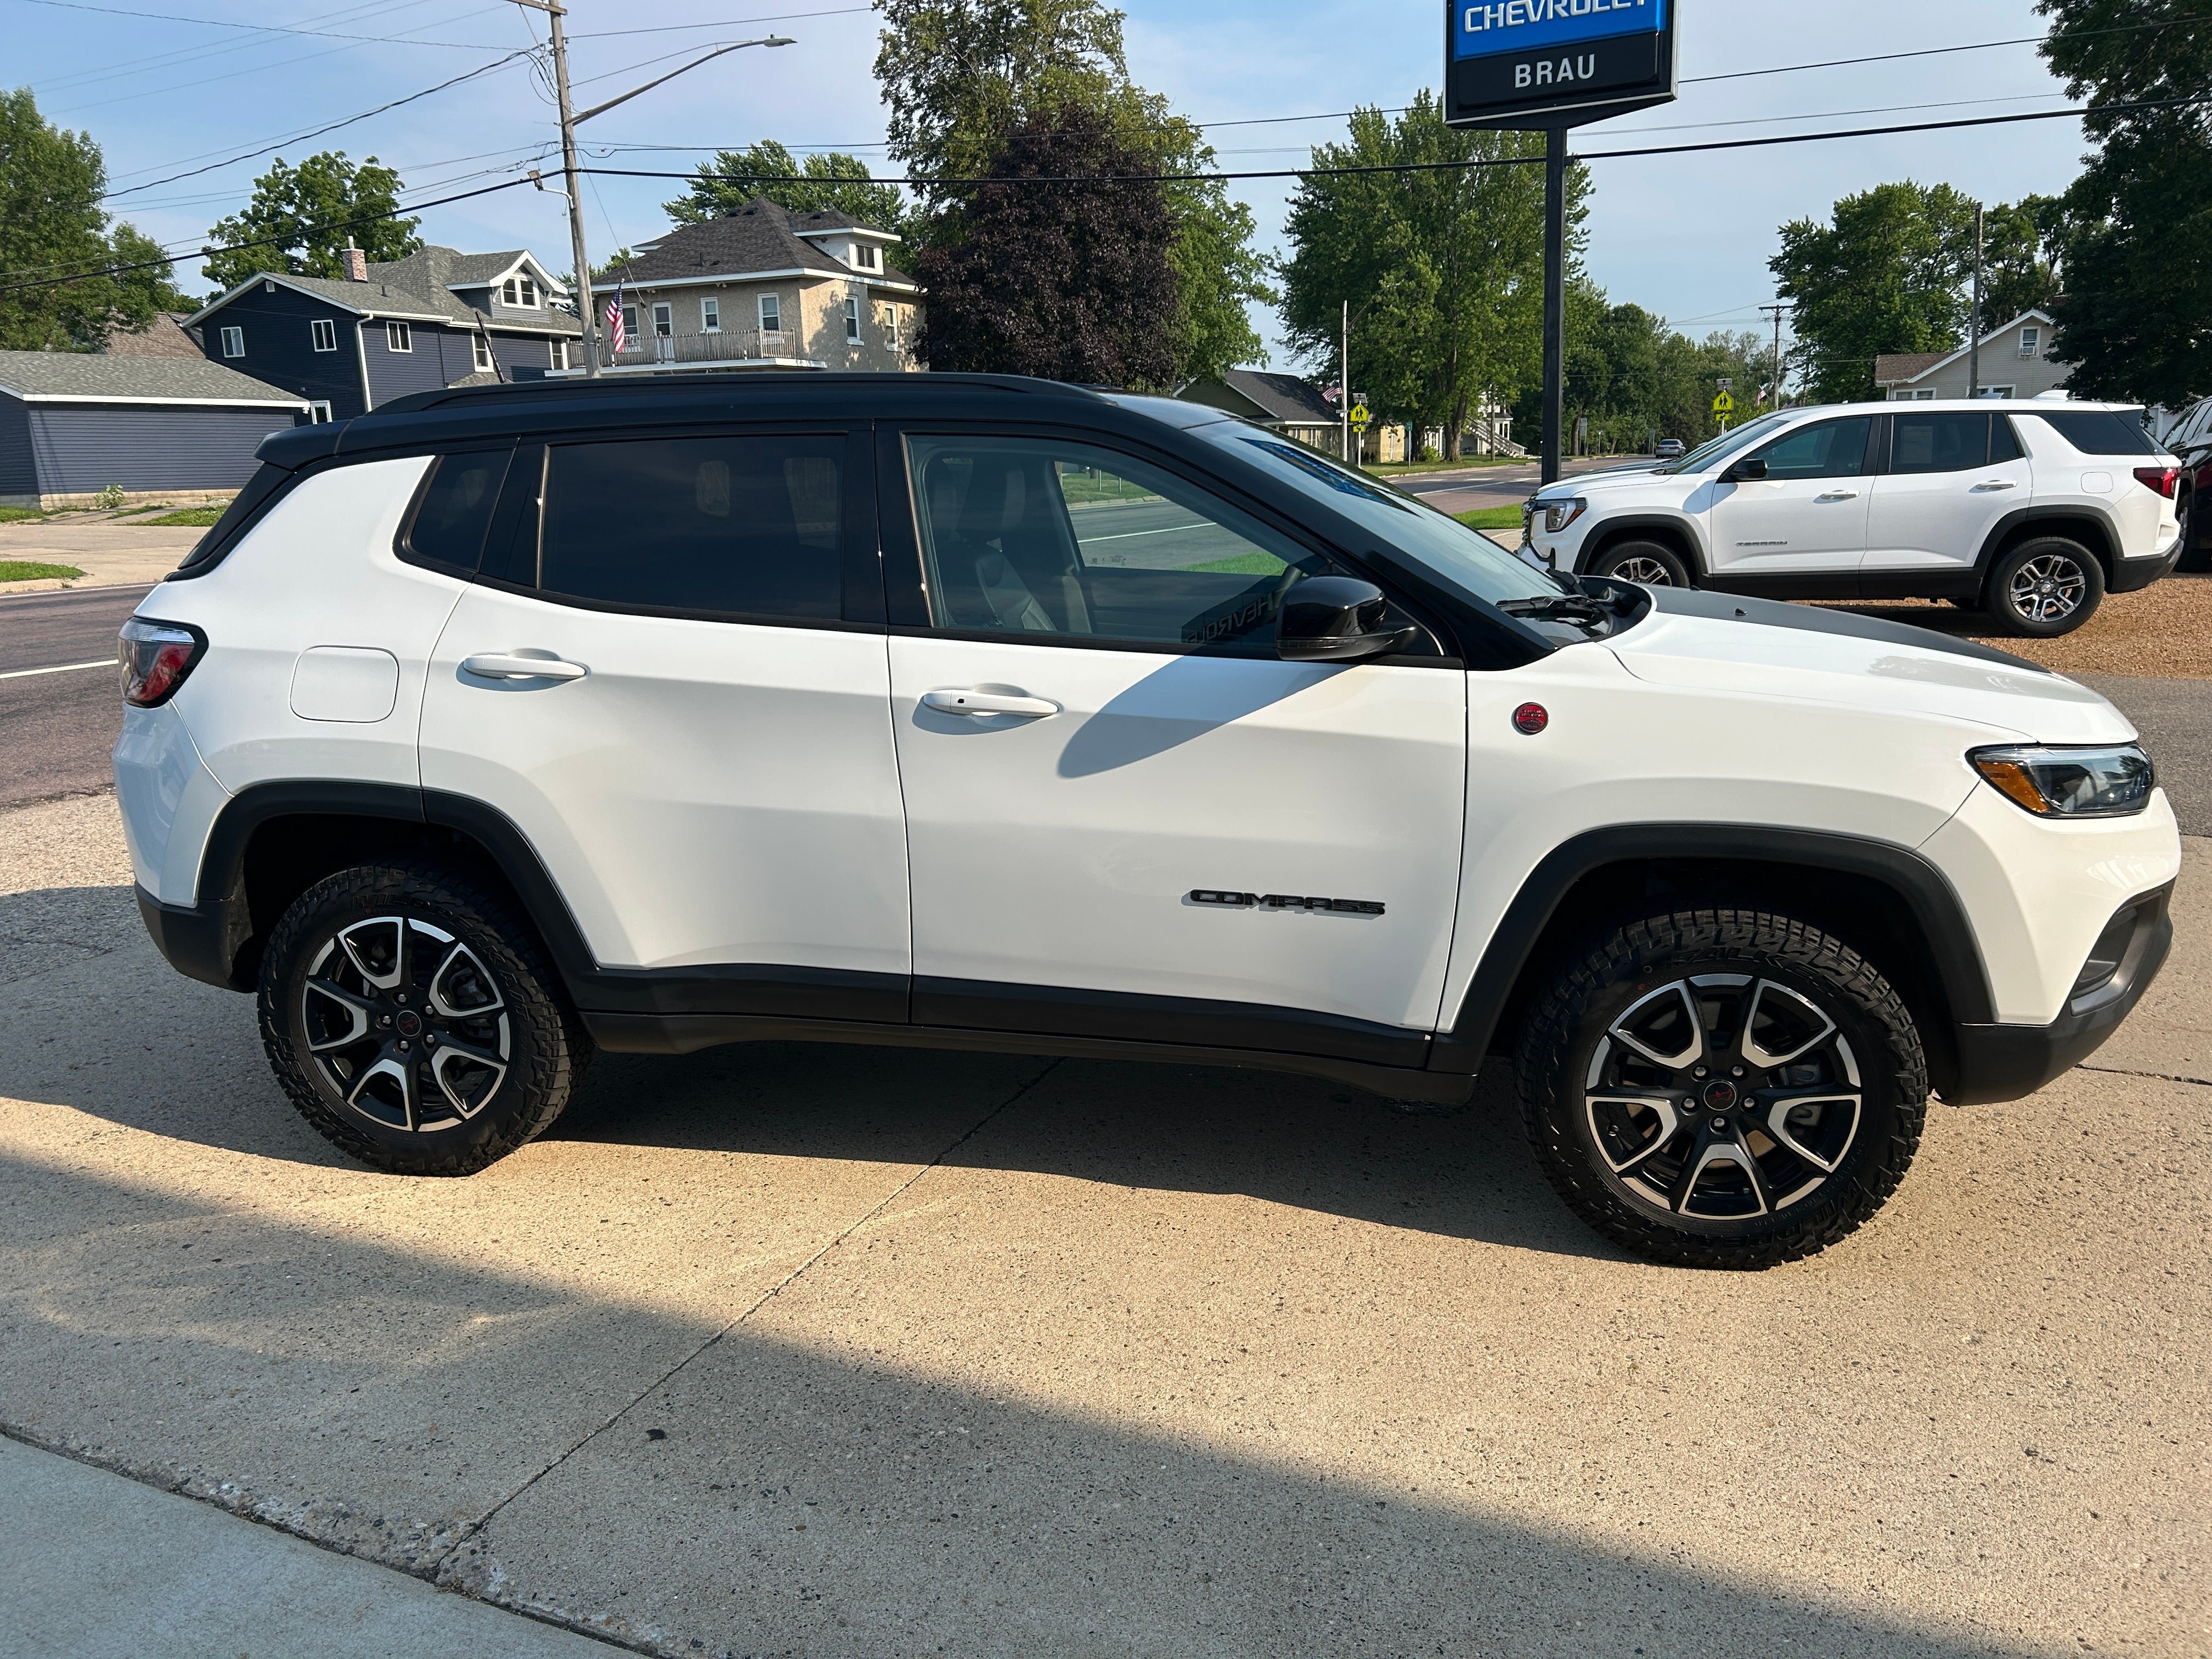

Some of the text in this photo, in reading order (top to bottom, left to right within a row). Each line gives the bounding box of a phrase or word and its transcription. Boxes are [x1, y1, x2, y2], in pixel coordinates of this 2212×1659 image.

[1465, 0, 1644, 32] CHEVROL
[1515, 54, 1595, 88] BRAU
[1190, 889, 1385, 915] COMPASS
